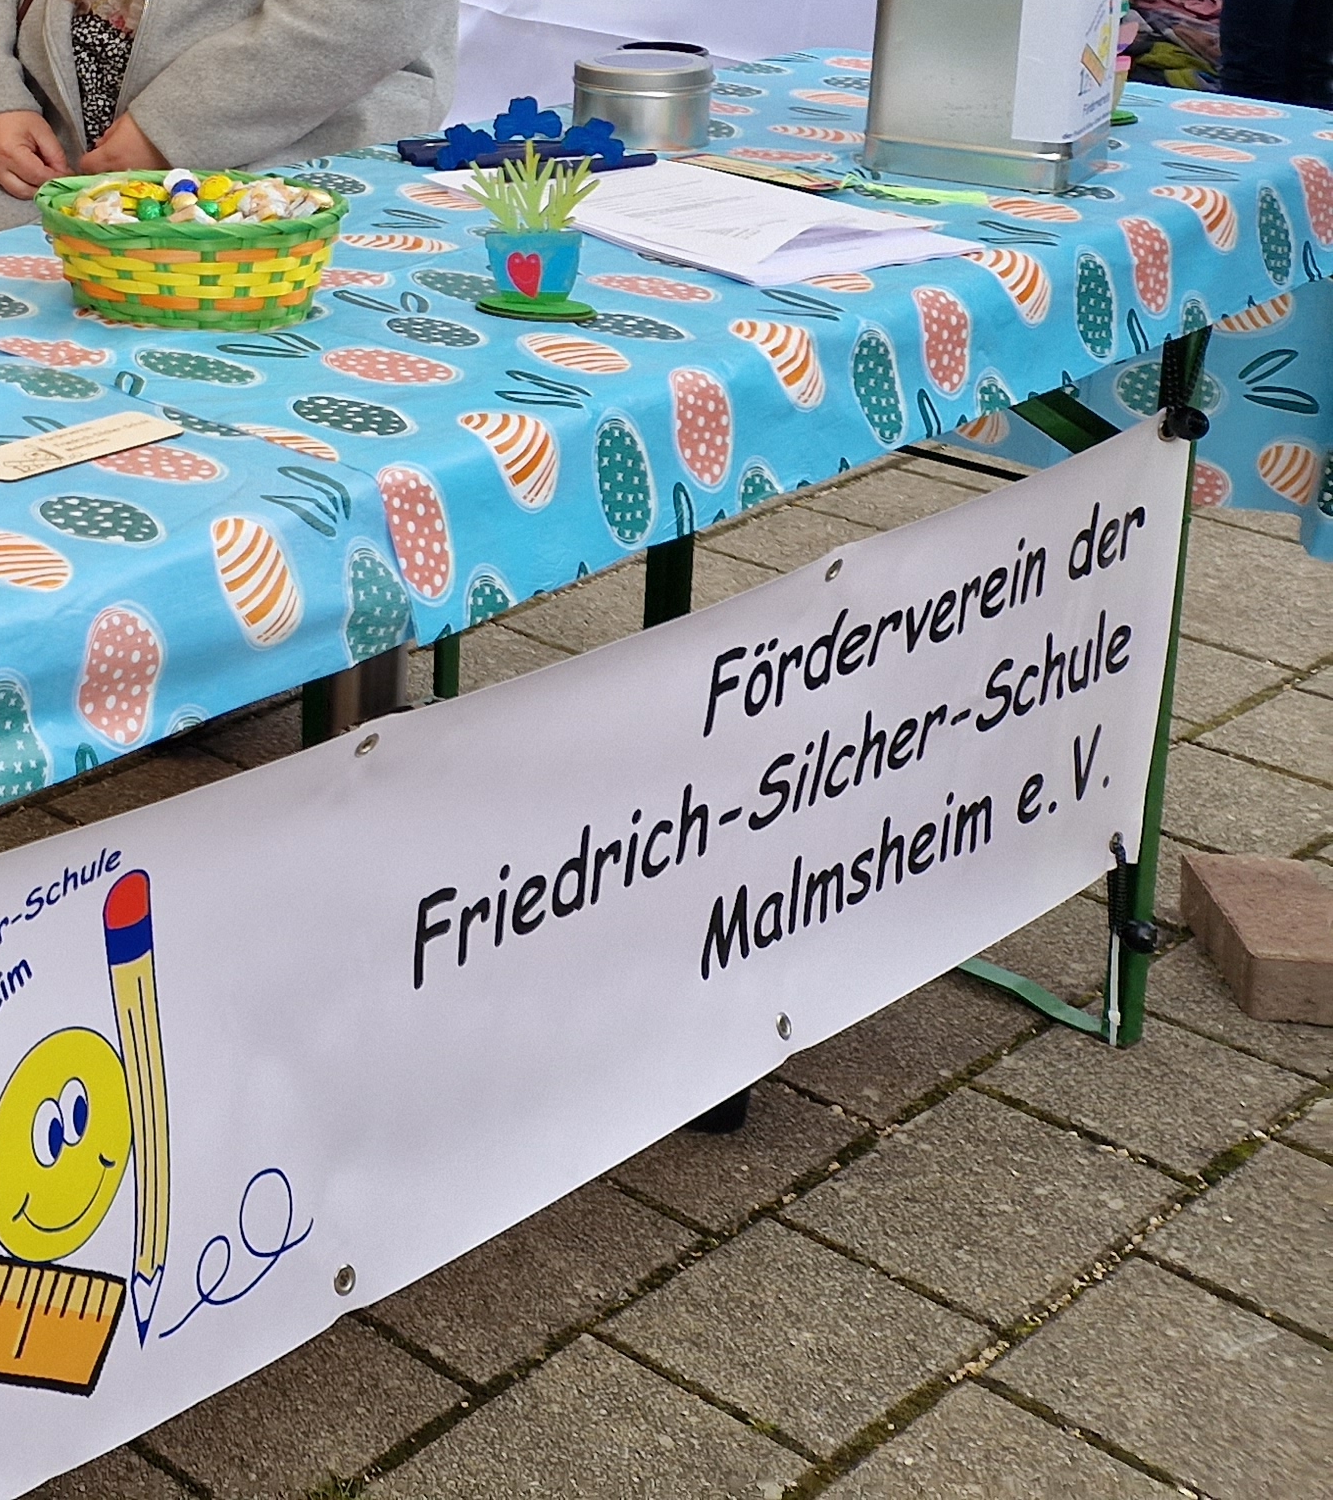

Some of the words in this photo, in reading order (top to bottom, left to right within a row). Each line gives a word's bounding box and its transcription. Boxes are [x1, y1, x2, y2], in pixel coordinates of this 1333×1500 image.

[702, 539, 1046, 738] Förderverein
[1067, 503, 1146, 581] der
[413, 609, 1131, 990] Friedrich-Silcher-Schule
[699, 792, 993, 981] Malmsheim
